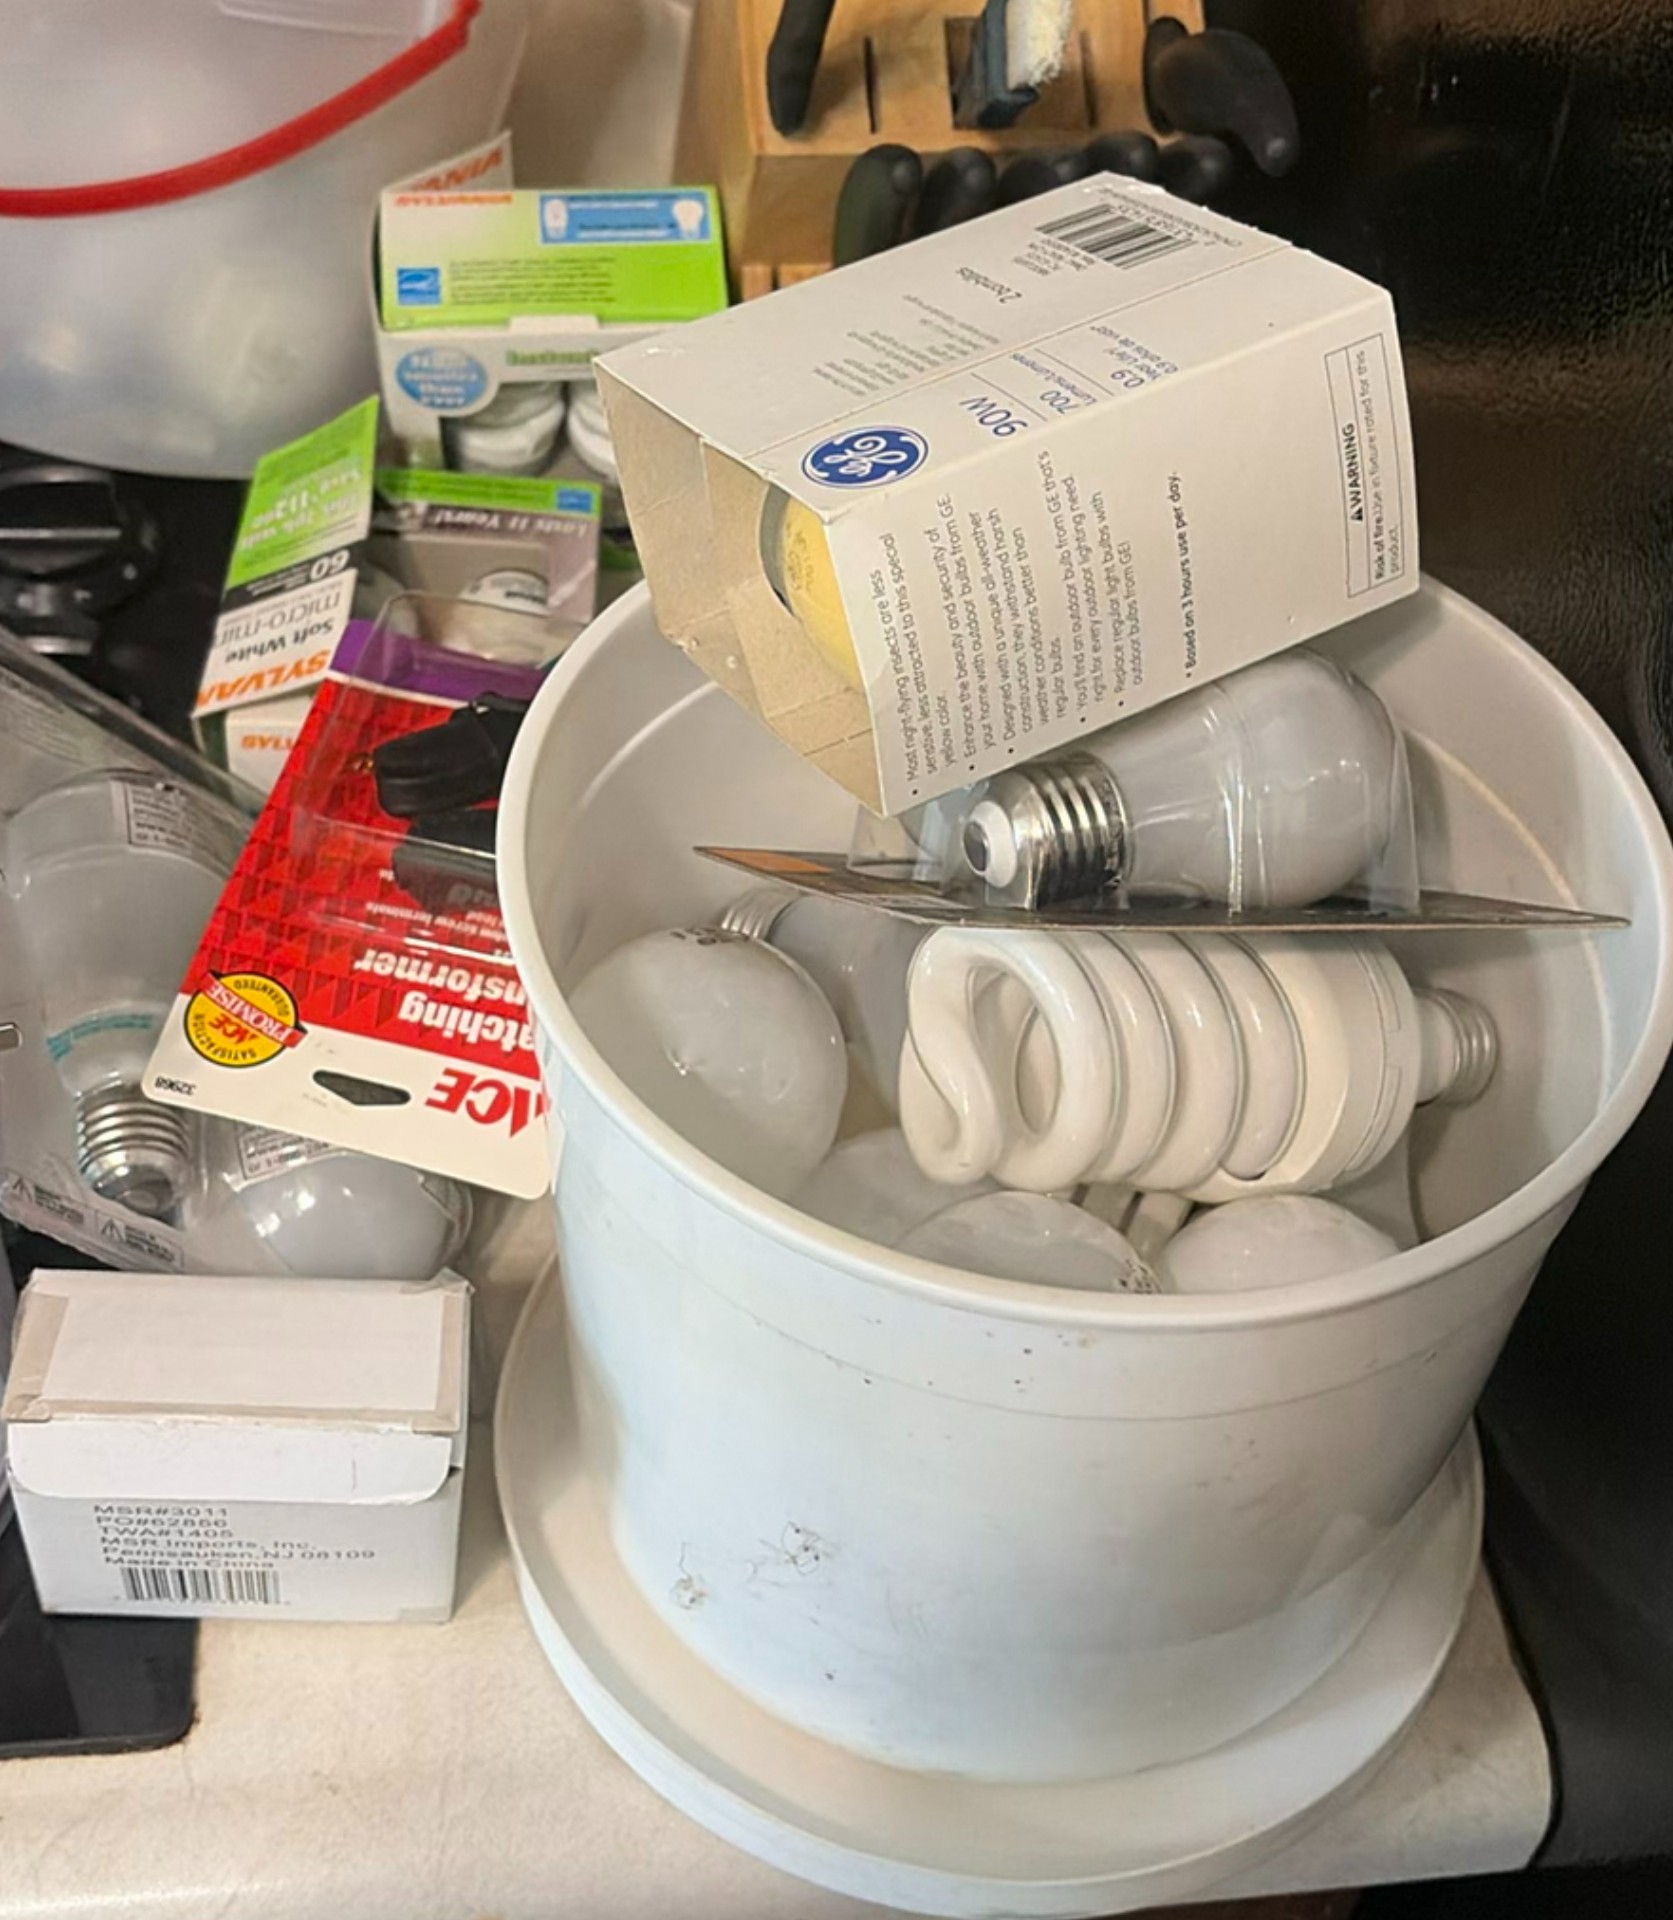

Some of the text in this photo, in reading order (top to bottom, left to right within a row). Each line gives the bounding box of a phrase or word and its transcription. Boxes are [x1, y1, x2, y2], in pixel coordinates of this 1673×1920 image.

[1110, 369, 1144, 387] 0.9
[1356, 350, 1366, 375] this
[1039, 390, 1078, 414] 700
[1359, 379, 1369, 396] for
[960, 397, 1027, 436] 90W
[1361, 398, 1374, 432] rated
[1038, 450, 1055, 491] that's
[1342, 423, 1360, 507] WARNING
[1368, 435, 1378, 475] fixture
[1045, 493, 1061, 513] GE
[946, 519, 961, 555] from
[1053, 514, 1067, 548] from
[1072, 513, 1091, 565] lighting
[1373, 540, 1384, 552] of
[310, 548, 350, 580] 60
[879, 533, 903, 583] special
[955, 556, 971, 596] bulbs
[1059, 549, 1074, 580] bulb
[1168, 472, 1196, 668] Based on 3 hours use per day.
[1375, 554, 1384, 579] Risk
[895, 585, 910, 612] this
[1066, 584, 1081, 632] outdoor
[1081, 567, 1097, 616] outdoor
[1090, 491, 1126, 693] Replace regular light bulbs with
[902, 613, 914, 629] to
[963, 599, 981, 651] outdoor
[969, 512, 1015, 740] Designed with a unique all-weather
[987, 508, 1032, 732] construction, they withstand harsh
[1012, 527, 1048, 724] weather conditions better than
[1117, 541, 1142, 685] outdoor bulbs from GE!
[225, 618, 334, 664] Soft White
[923, 528, 976, 757] Enhance the beauty and security of
[1073, 634, 1083, 651] an
[1090, 620, 1101, 652] every
[869, 569, 917, 781] Most night-flying insects are less
[904, 631, 926, 692] attracted
[972, 652, 985, 680] with
[1072, 652, 1084, 677] find
[1091, 656, 1101, 673] for
[978, 684, 989, 720] home
[1052, 677, 1068, 718] regular
[1092, 673, 1106, 702] right
[918, 694, 929, 721] less
[940, 728, 956, 766] yellow
[982, 723, 996, 749] your
[366, 902, 433, 927] terminals
[434, 915, 478, 937] screw
[353, 947, 531, 1009] nsformer
[208, 982, 291, 1041] PROMISE
[233, 978, 288, 1017] GUARANTEED
[191, 1013, 256, 1061] SATISFACTION
[208, 1013, 258, 1044] ACE
[398, 992, 538, 1052] atching
[154, 1077, 197, 1097] 32968
[425, 1067, 551, 1138] ACE
[105, 1556, 275, 1570] Made in China
